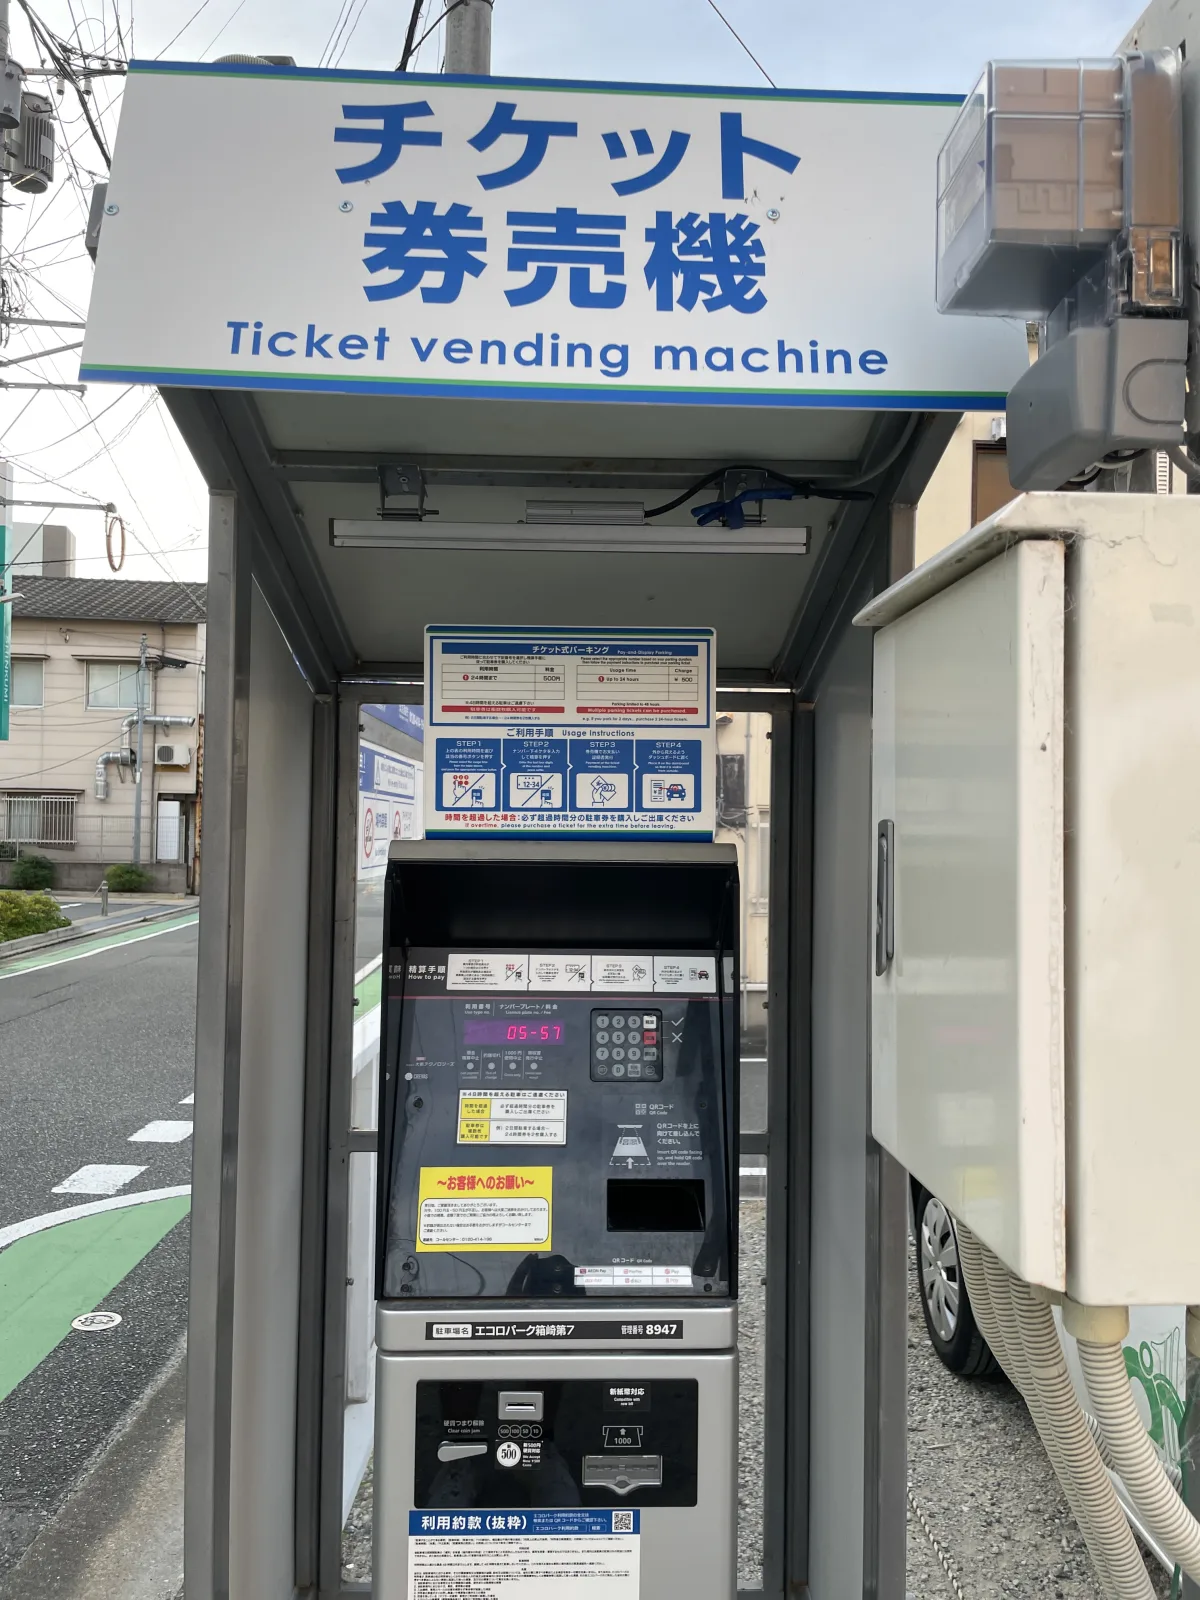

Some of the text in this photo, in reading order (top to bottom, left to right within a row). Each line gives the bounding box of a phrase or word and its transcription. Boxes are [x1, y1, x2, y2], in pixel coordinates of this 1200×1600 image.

[333, 100, 801, 200] チケット
[362, 200, 768, 315] 券売機
[227, 321, 889, 378] Ticket vending machine
[532, 646, 609, 654] チケット式パーキング
[506, 728, 554, 737] ご利用手順
[507, 1026, 560, 1039] 05-57
[435, 1327, 469, 1335] 駐車場名
[475, 1325, 575, 1336] エコロパーク箱崎第7
[621, 1325, 677, 1335] 管理番号 8947
[501, 1449, 516, 1459] 500
